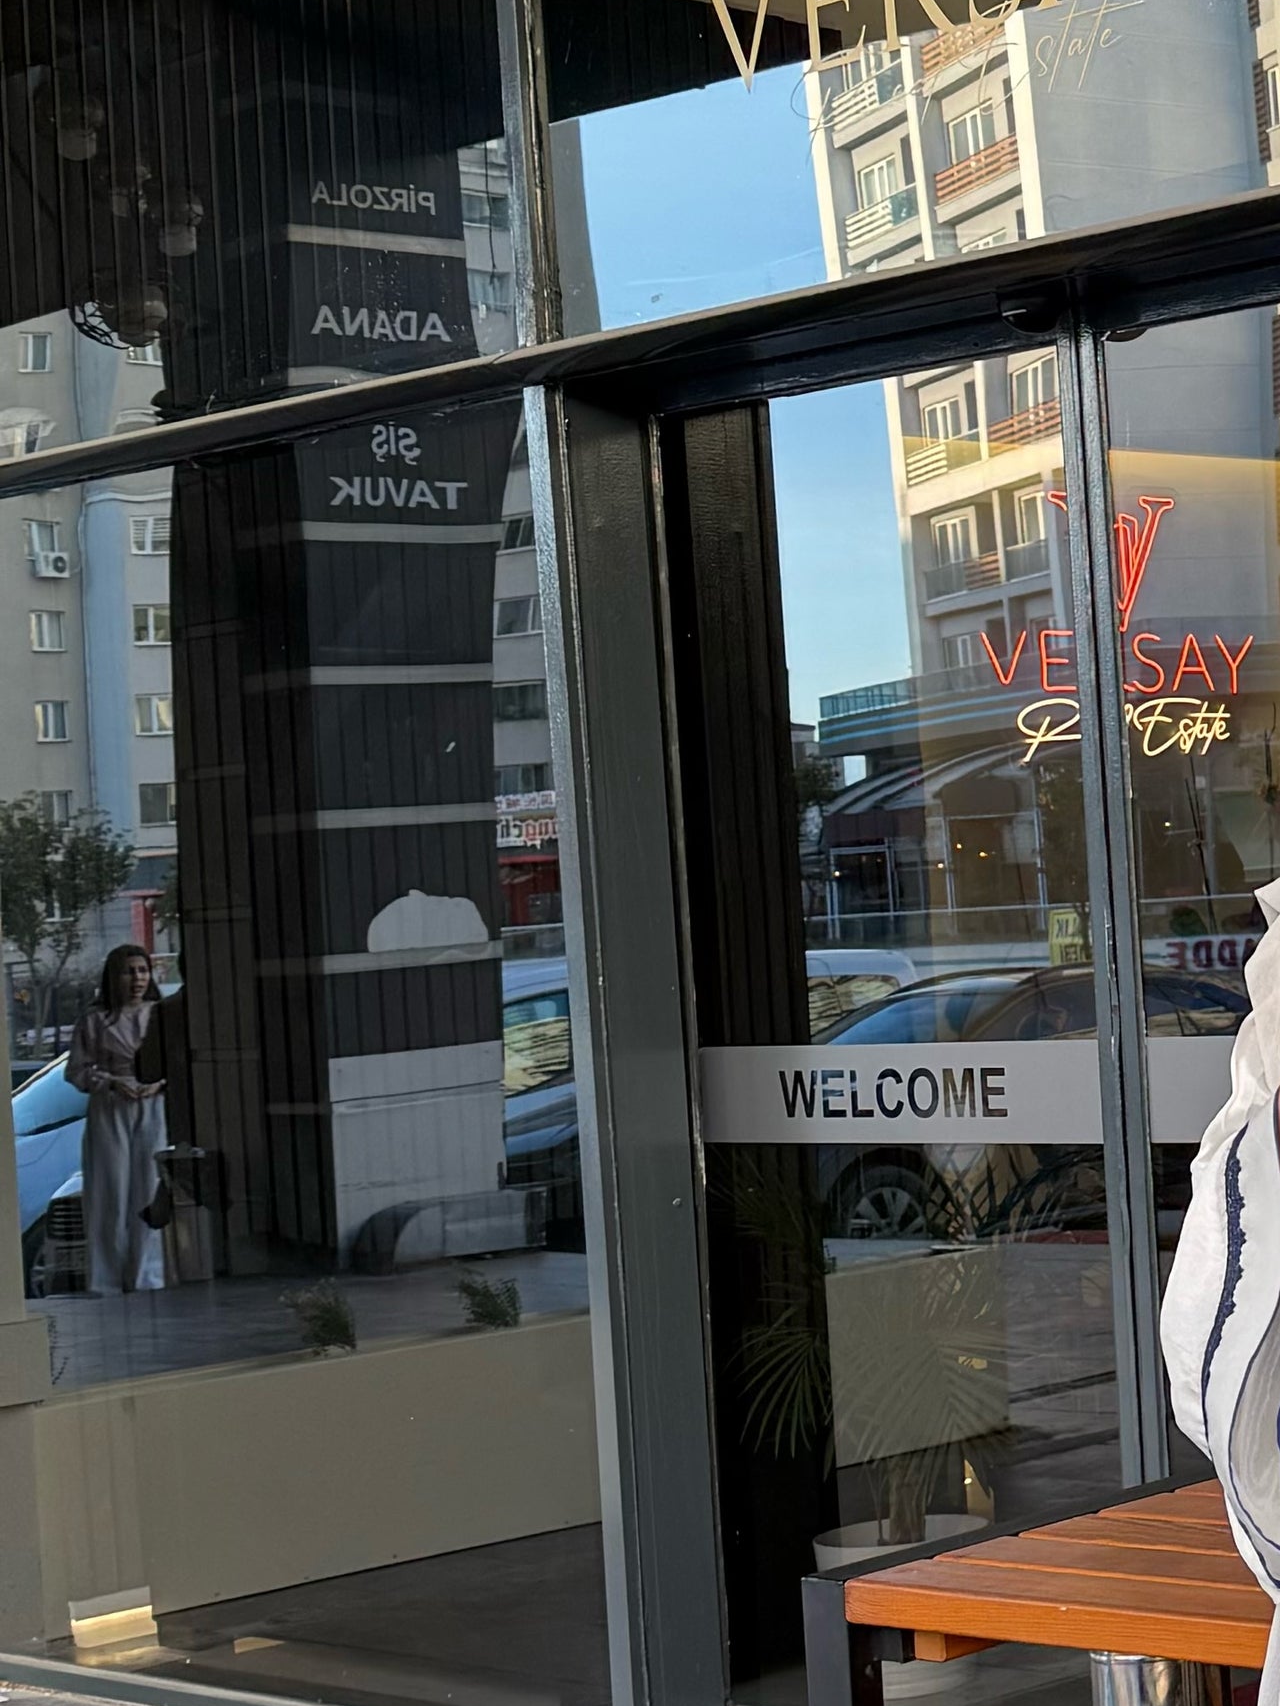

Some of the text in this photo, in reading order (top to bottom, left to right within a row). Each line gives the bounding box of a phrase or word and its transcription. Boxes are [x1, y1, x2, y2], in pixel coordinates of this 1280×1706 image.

[979, 629, 1254, 695] VESAY
[1132, 696, 1232, 757] Estate
[778, 1067, 1009, 1119] WELCOME
